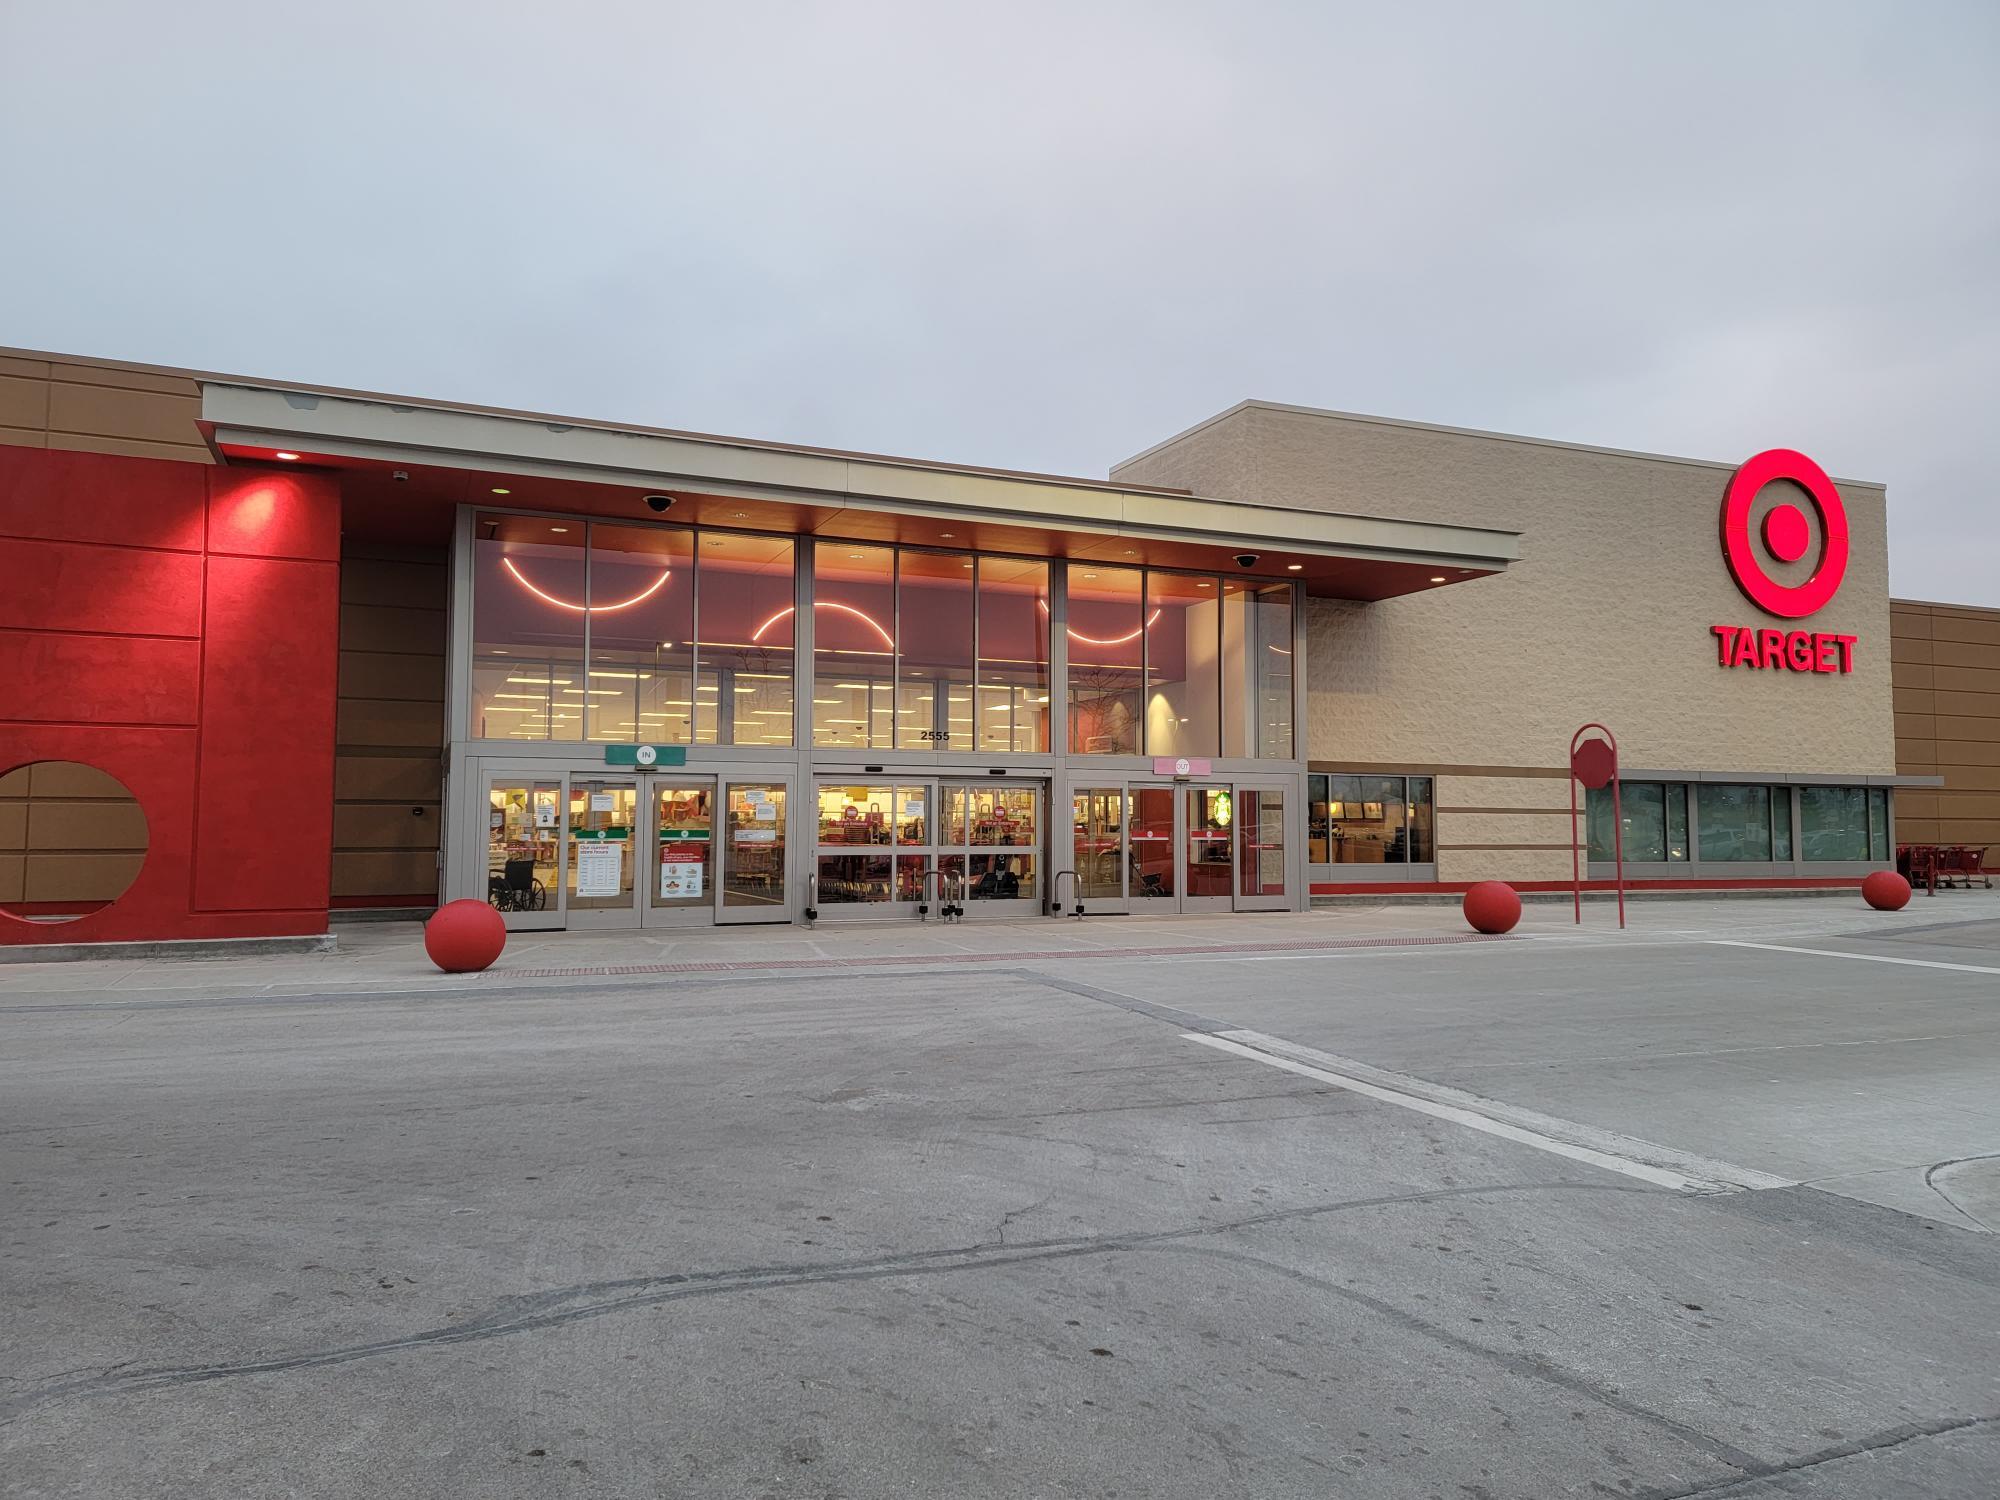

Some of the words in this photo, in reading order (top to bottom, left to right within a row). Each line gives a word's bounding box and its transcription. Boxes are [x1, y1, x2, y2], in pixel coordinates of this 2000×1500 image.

[1710, 625, 1858, 674] TARGET
[920, 731, 950, 741] 2555
[642, 751, 651, 759] IN
